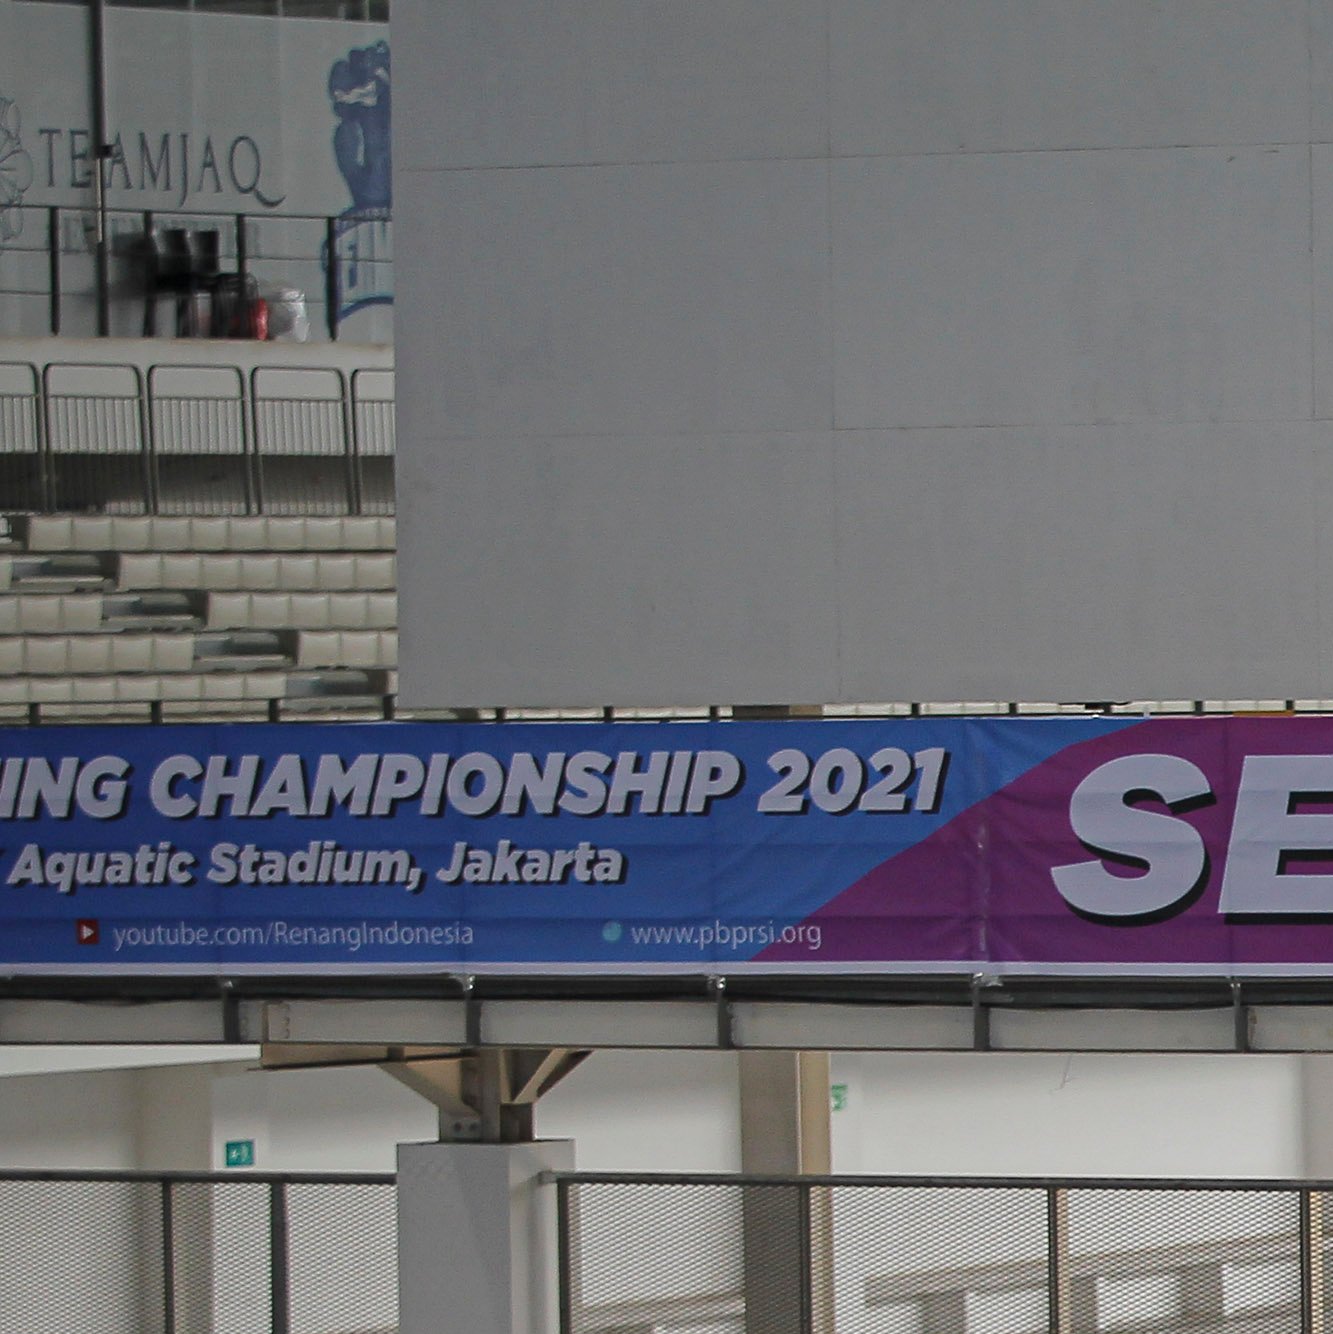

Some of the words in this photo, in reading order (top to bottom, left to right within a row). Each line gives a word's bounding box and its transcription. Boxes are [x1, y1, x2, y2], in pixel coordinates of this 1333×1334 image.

[0, 755, 130, 818] ING
[150, 751, 741, 818] CHAMPIONSHIP
[757, 748, 945, 812] 2021
[6, 841, 195, 892] Aquatic
[207, 841, 423, 890] Stadium,
[436, 840, 624, 882] Jakarta
[113, 920, 473, 951] youtube.com/RenangIndonesia
[632, 921, 822, 951] www.pbprsi.org
